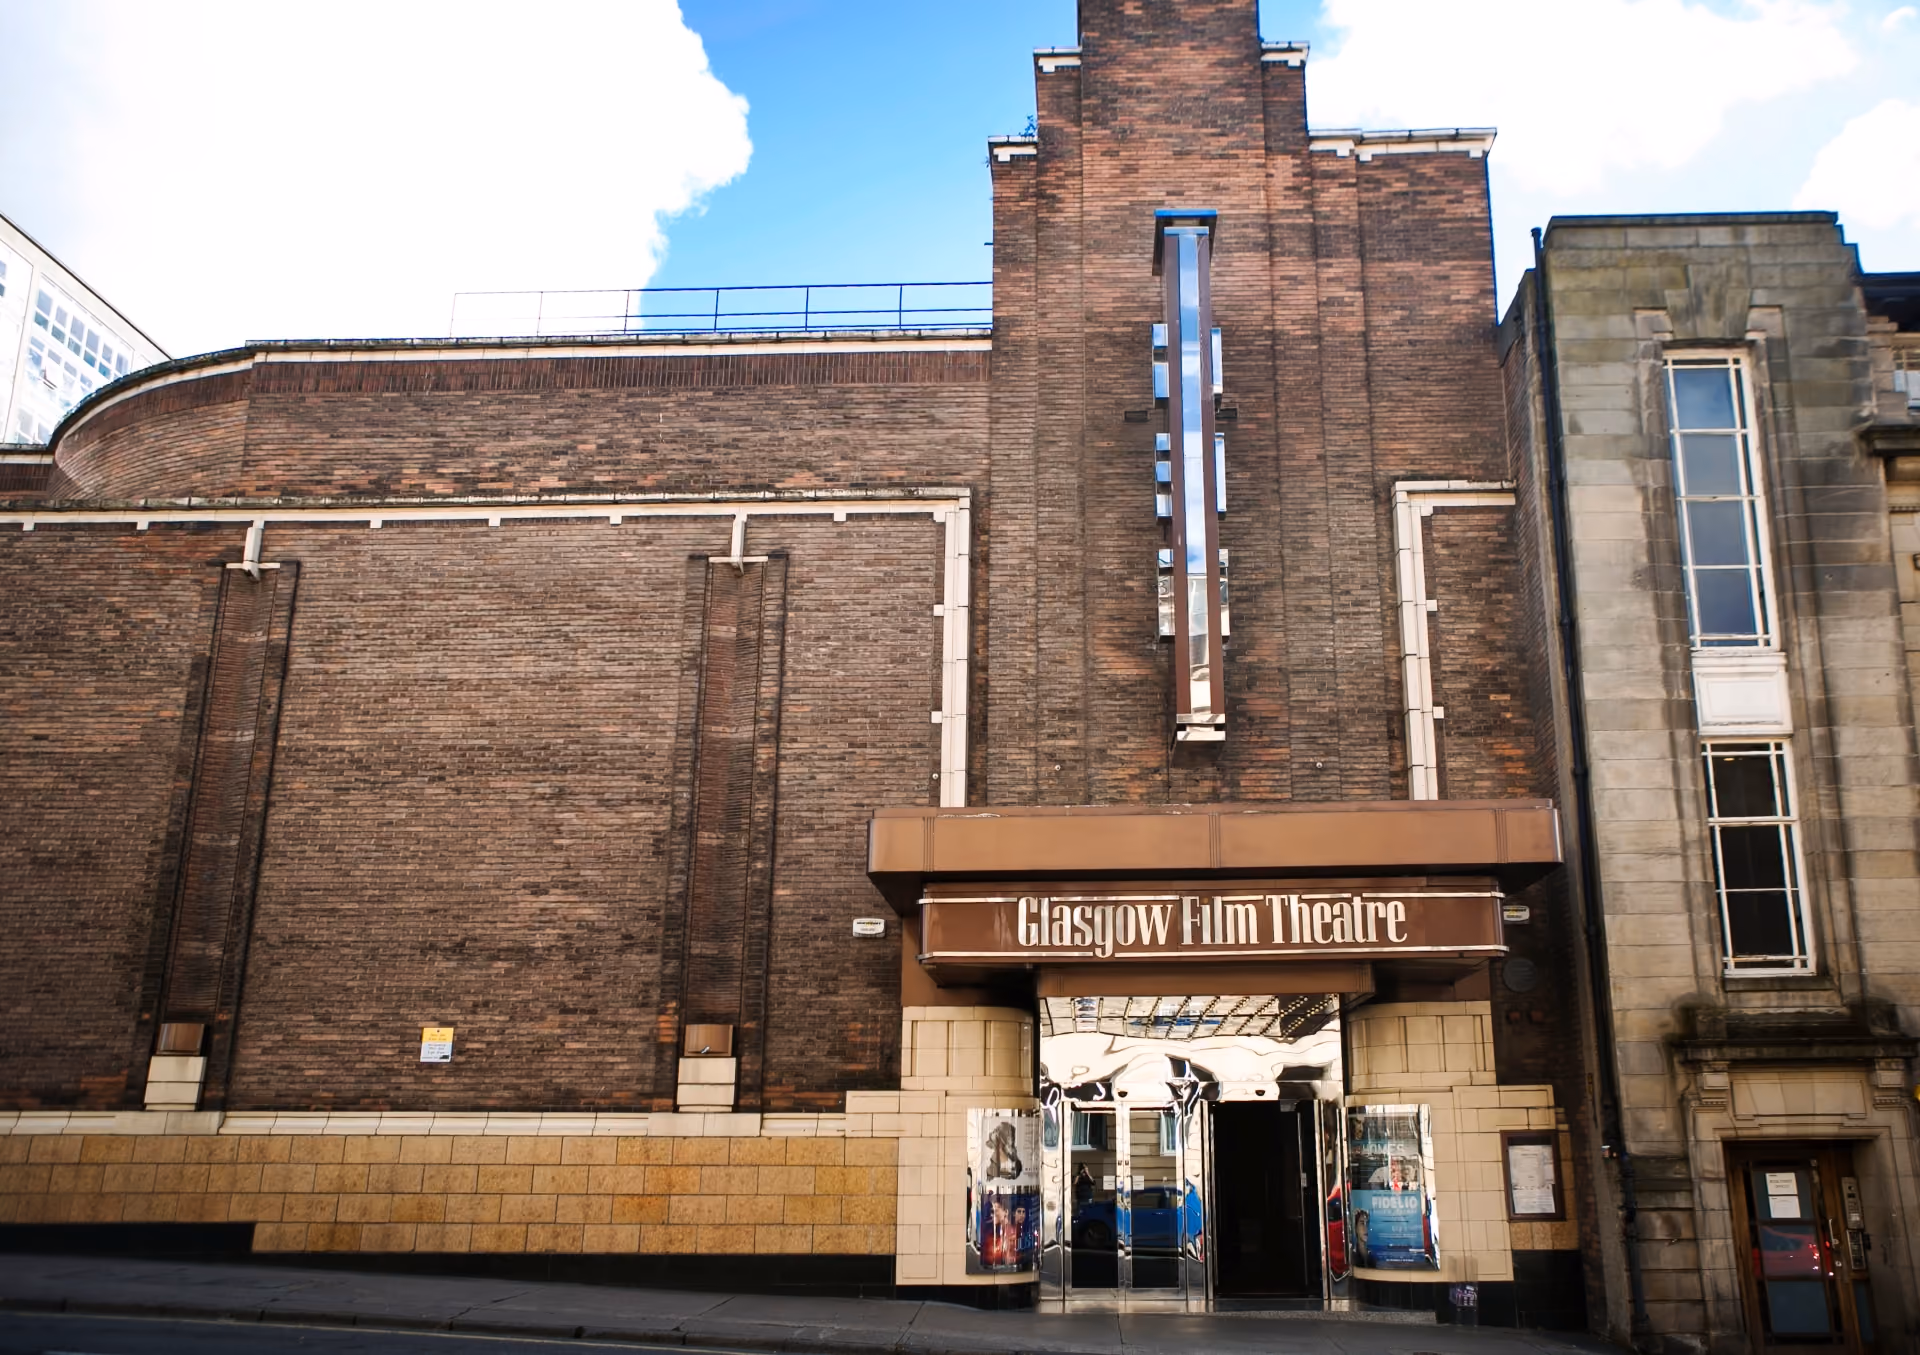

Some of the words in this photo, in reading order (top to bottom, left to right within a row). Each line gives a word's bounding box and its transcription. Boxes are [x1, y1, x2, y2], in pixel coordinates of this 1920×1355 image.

[1018, 896, 1173, 958] Glasgow
[1180, 895, 1260, 945] Film
[1265, 894, 1408, 944] Theatre
[1371, 1195, 1418, 1209] FIDELIO
